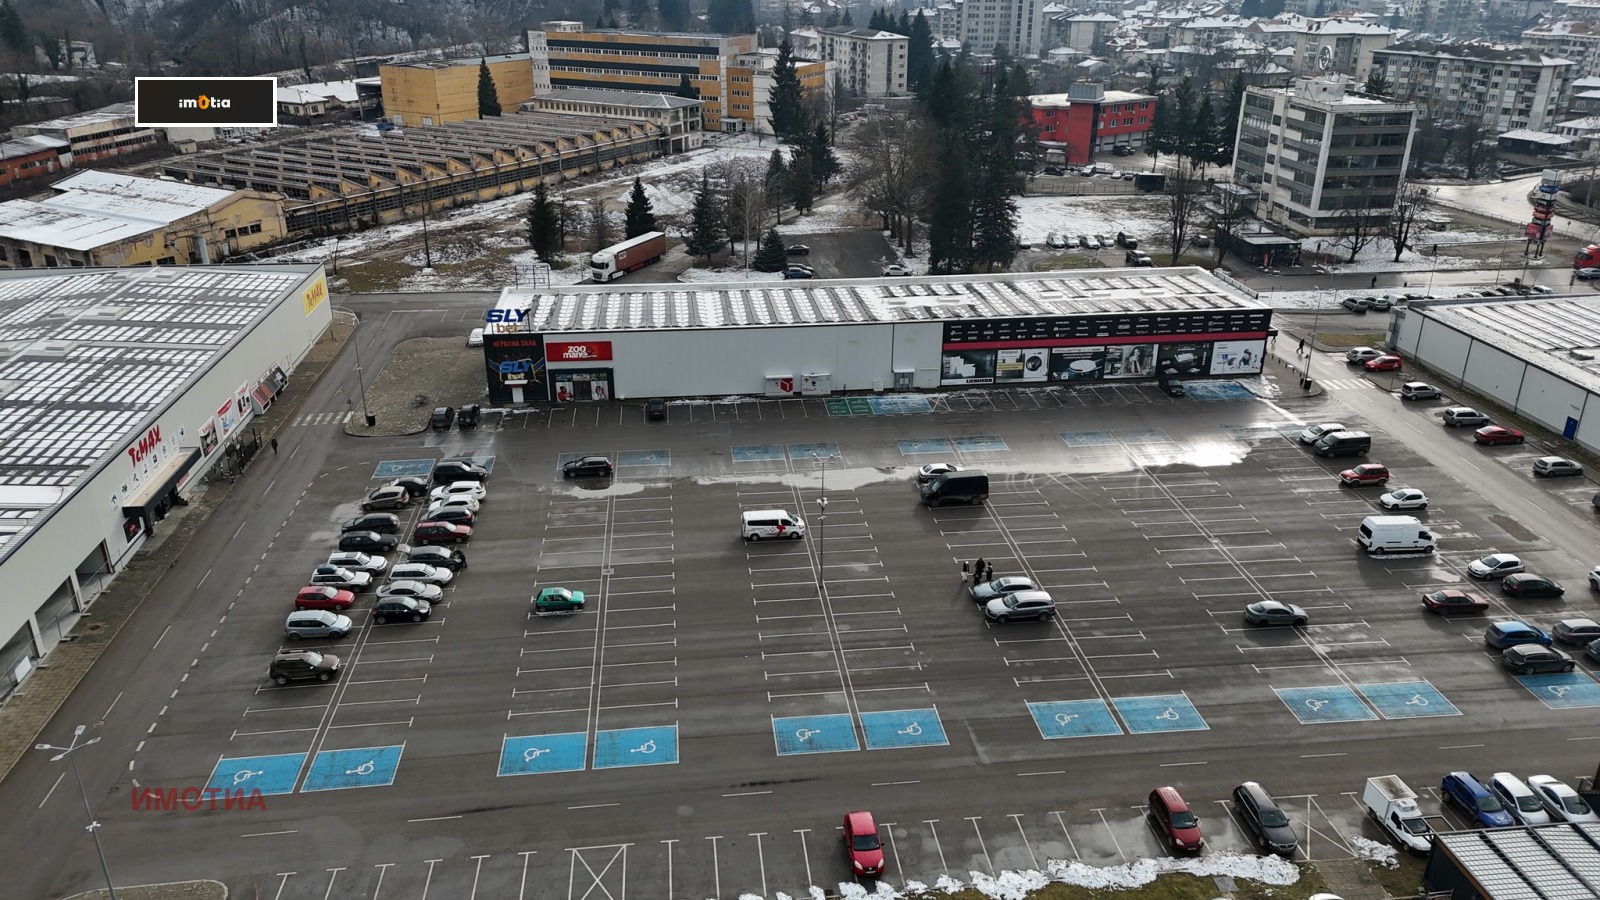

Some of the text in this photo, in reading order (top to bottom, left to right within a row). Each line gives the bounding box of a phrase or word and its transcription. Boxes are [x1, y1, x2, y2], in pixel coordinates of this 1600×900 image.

[486, 308, 531, 323] SLY
[496, 323, 520, 333] bet
[500, 360, 532, 373] SLY
